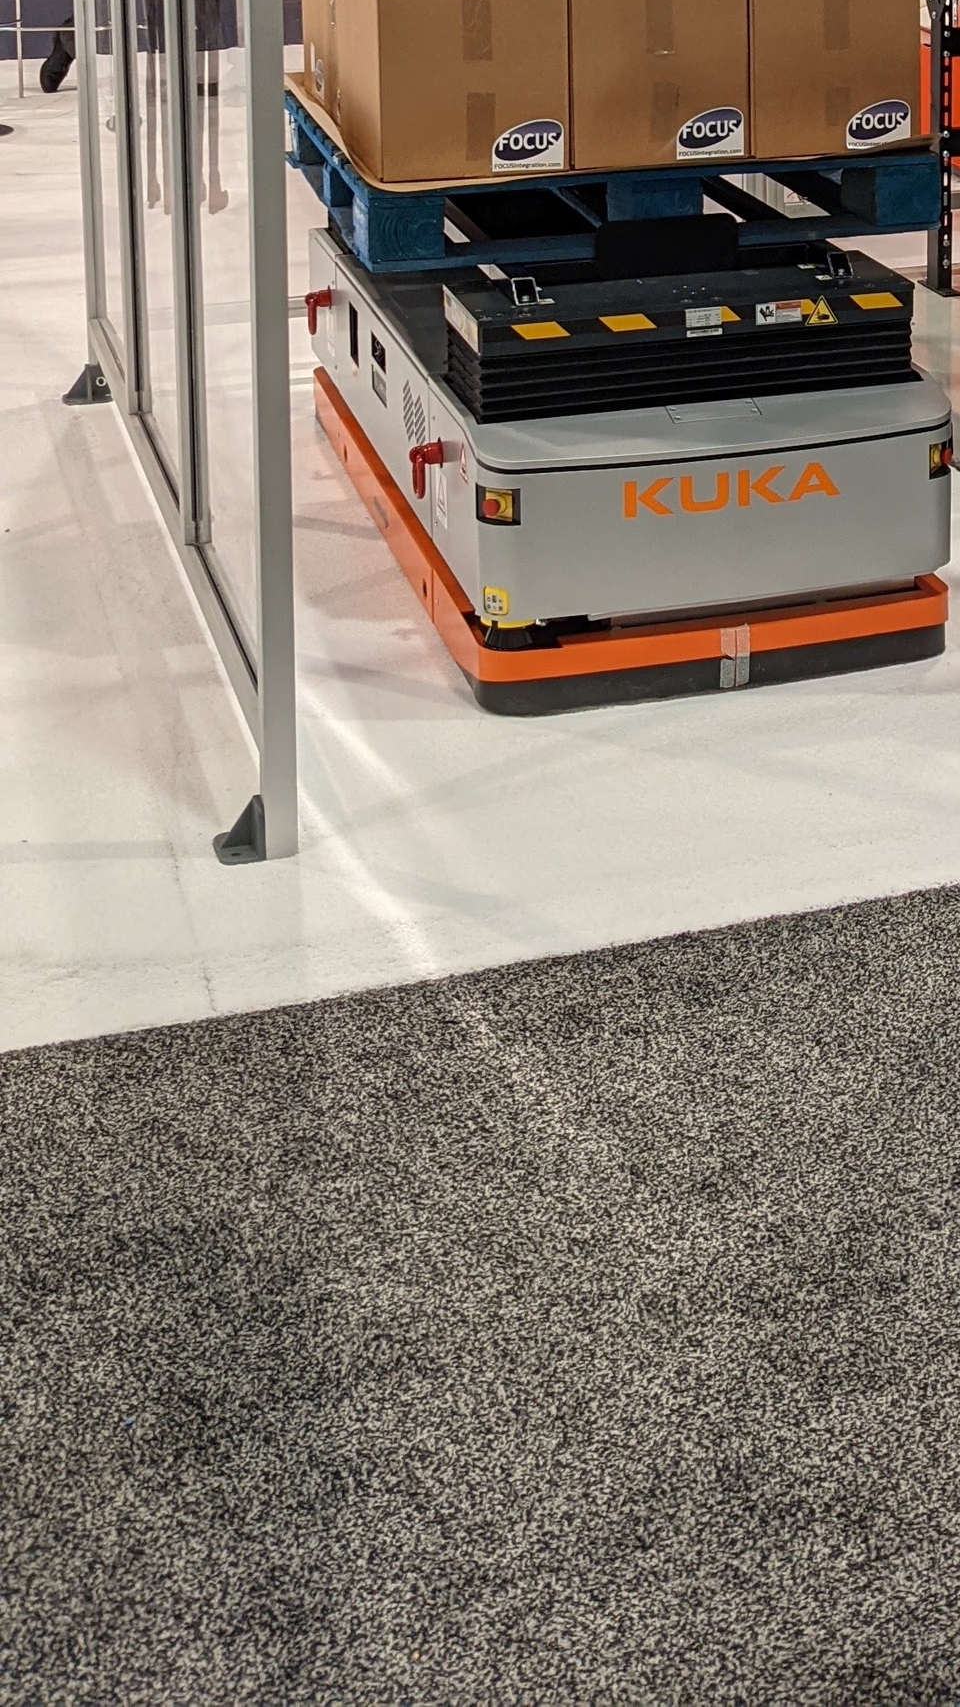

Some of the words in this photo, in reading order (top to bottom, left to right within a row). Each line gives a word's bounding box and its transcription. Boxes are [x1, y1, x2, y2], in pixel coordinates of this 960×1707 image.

[682, 119, 738, 140] FOCUS
[851, 112, 905, 131] FOCUS
[498, 131, 559, 151] FOCUS
[623, 461, 841, 520] KUKA
